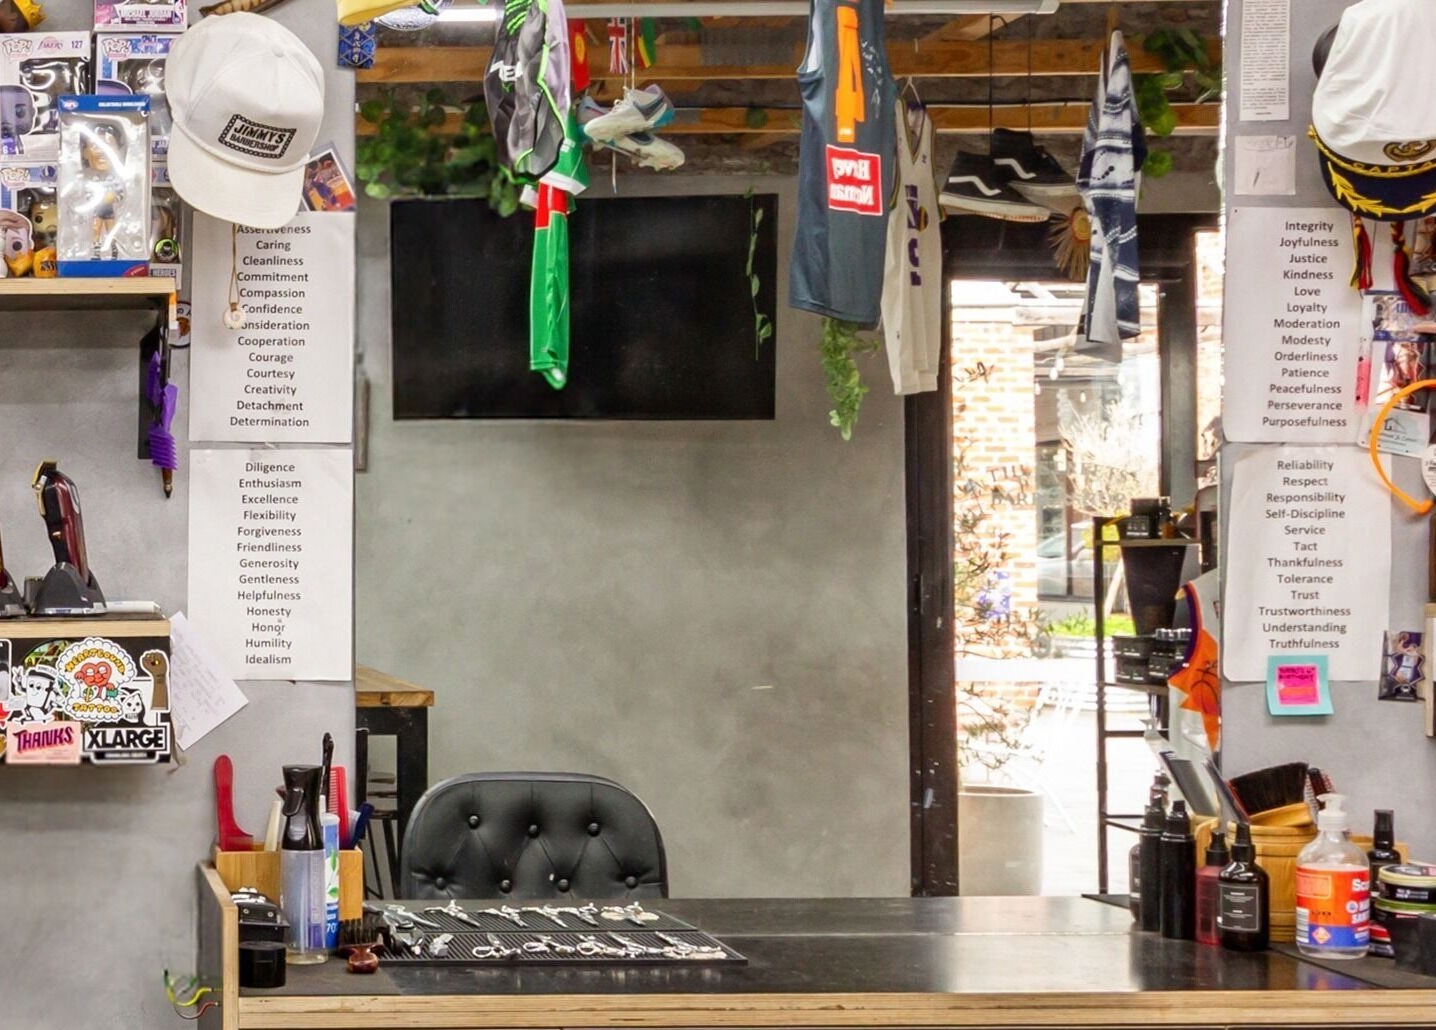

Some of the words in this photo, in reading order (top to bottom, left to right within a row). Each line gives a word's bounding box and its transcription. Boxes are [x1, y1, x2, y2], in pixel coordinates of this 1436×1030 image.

[71, 41, 83, 49] 127
[233, 124, 286, 144] JIMMYS
[229, 134, 280, 151] BARBERSHOP
[1285, 221, 1334, 233] Integrity
[256, 240, 291, 252] Caring
[1279, 237, 1339, 248] Joyfulness
[242, 255, 304, 266] Cleanliness
[1289, 254, 1328, 264] Justice
[237, 271, 309, 282] Commitment
[1283, 270, 1334, 280] Kindness
[239, 288, 306, 300] Compassion
[1294, 287, 1321, 297] Love
[242, 304, 303, 315] Confidence
[1287, 303, 1328, 314] Loyalty
[241, 320, 310, 331] onsideration
[1273, 319, 1341, 329] Moderation
[237, 336, 306, 348] Cooperation
[1281, 336, 1332, 347] Modesty
[248, 352, 294, 364] Courage
[1274, 352, 1339, 362] Orderliness
[246, 368, 296, 380] Courtesy
[1281, 368, 1330, 378] Patience
[244, 384, 297, 396] Creativity
[1269, 384, 1342, 394] Peacefulness
[236, 400, 304, 412] Detachment
[1267, 400, 1343, 411] Perseverance
[230, 416, 310, 428] Determination
[1262, 416, 1347, 428] Purposefulness
[245, 462, 295, 474] Diligence
[1277, 460, 1334, 472] Reliability
[239, 478, 302, 489] Enthusiasm
[1283, 476, 1328, 488] Respect
[242, 494, 299, 505] Excellence
[1266, 492, 1345, 504] Responsibility
[243, 510, 297, 522] Flexibility
[1265, 509, 1345, 521] Self-Discipline
[237, 526, 302, 538] Forgiveness
[1284, 525, 1326, 535] Service
[237, 542, 302, 553] Friendliness
[1293, 541, 1318, 552] Tact
[239, 558, 299, 570] Generosity
[1268, 557, 1344, 568] Thankfulness
[239, 574, 300, 585] Gentleness
[1277, 574, 1334, 584] Tolerance
[237, 590, 301, 602] Helpfulness
[1291, 590, 1320, 600] Trust
[246, 606, 292, 618] Honesty
[1259, 606, 1351, 617] Trustworthiness
[252, 622, 285, 633] Honor
[1262, 622, 1347, 634] Understanding
[245, 638, 292, 650] Humility
[1269, 639, 1340, 649] Truthfulness
[245, 654, 292, 665] Idealism
[71, 703, 119, 714] TATTOO
[13, 726, 74, 753] THANKS
[87, 728, 164, 749] XLARGE
